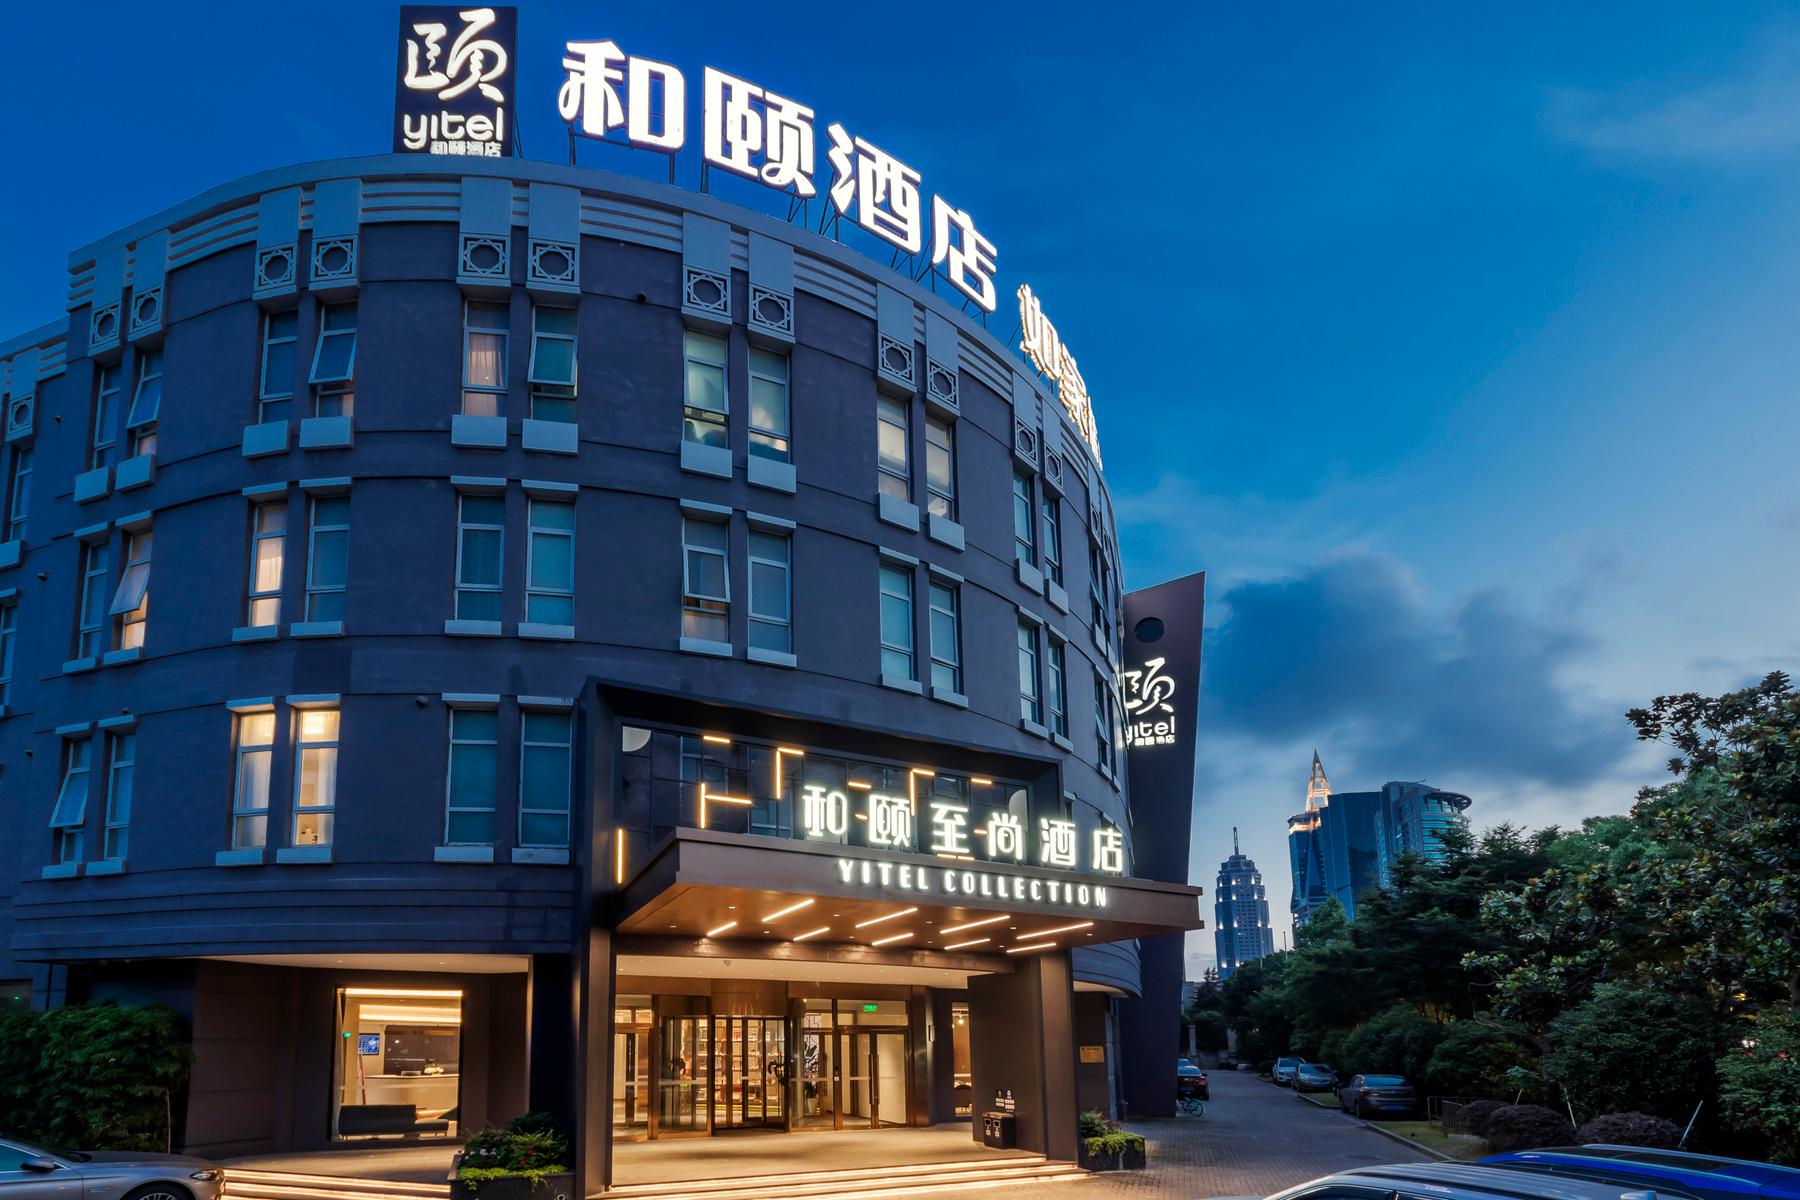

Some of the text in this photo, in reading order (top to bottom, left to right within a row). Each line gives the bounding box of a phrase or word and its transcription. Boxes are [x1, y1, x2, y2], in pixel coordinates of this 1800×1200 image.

[403, 107, 504, 149] yitel
[558, 39, 998, 312] 和颐酒店
[802, 785, 1124, 872] 和颐至尚酒店
[838, 860, 1107, 907] YITEL COLLECTION
